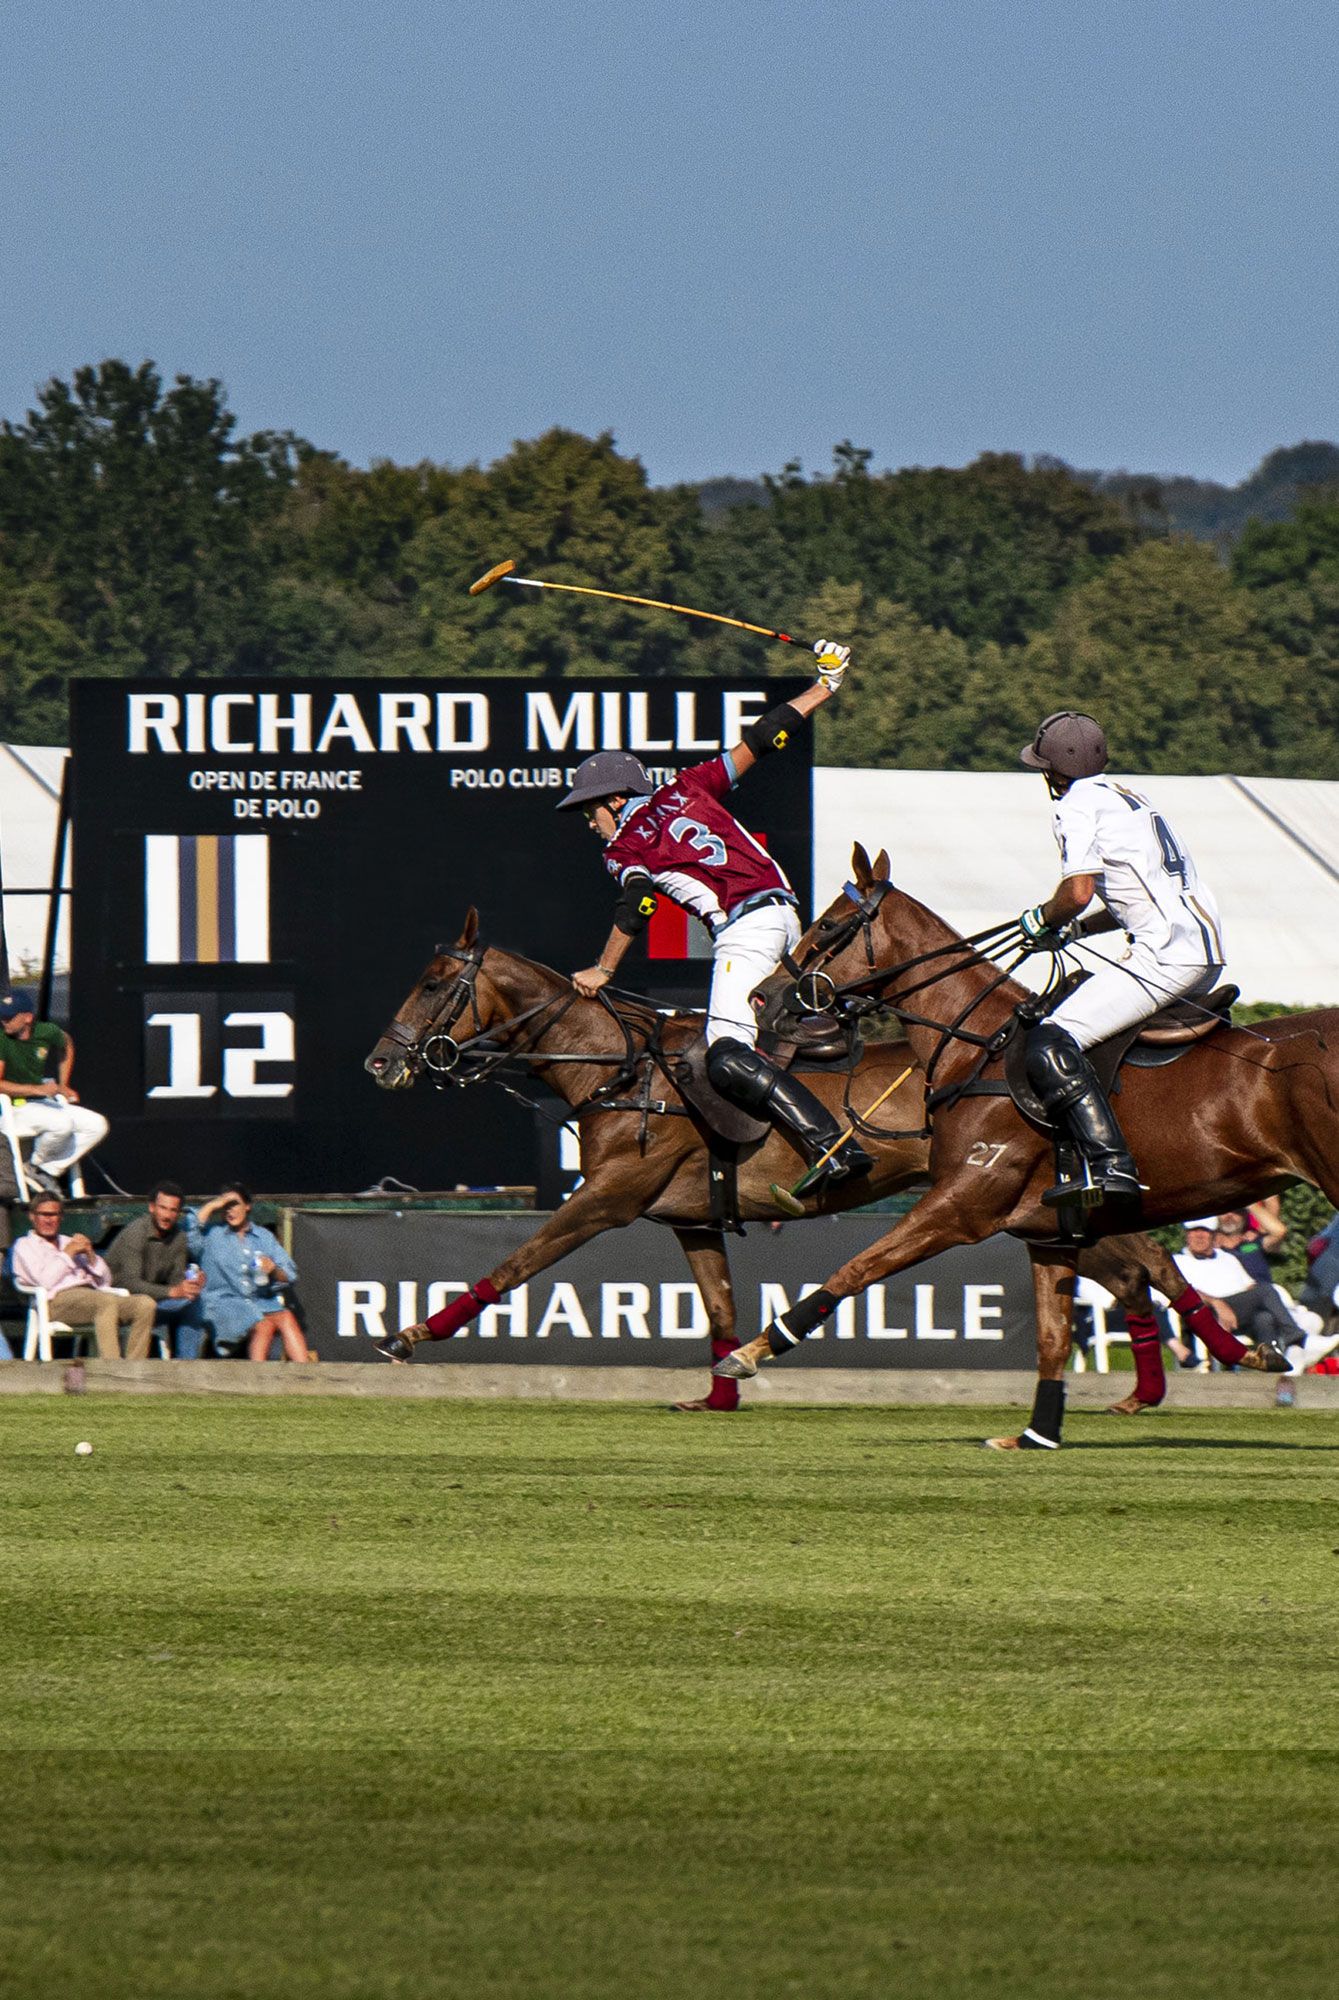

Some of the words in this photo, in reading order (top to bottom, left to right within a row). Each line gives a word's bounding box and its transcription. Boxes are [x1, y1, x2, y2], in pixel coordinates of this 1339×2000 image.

[128, 693, 490, 753] RICHARD
[190, 771, 246, 790] OPEN
[250, 771, 277, 790] DE
[281, 770, 362, 790] FRANCE
[450, 768, 506, 788] POLO
[508, 767, 563, 788] CLUB
[234, 799, 262, 818] DE
[266, 799, 321, 818] POLO
[668, 816, 728, 866] 3
[1150, 811, 1190, 891] 4
[147, 1012, 294, 1098] 12
[966, 1141, 1008, 1169] 27
